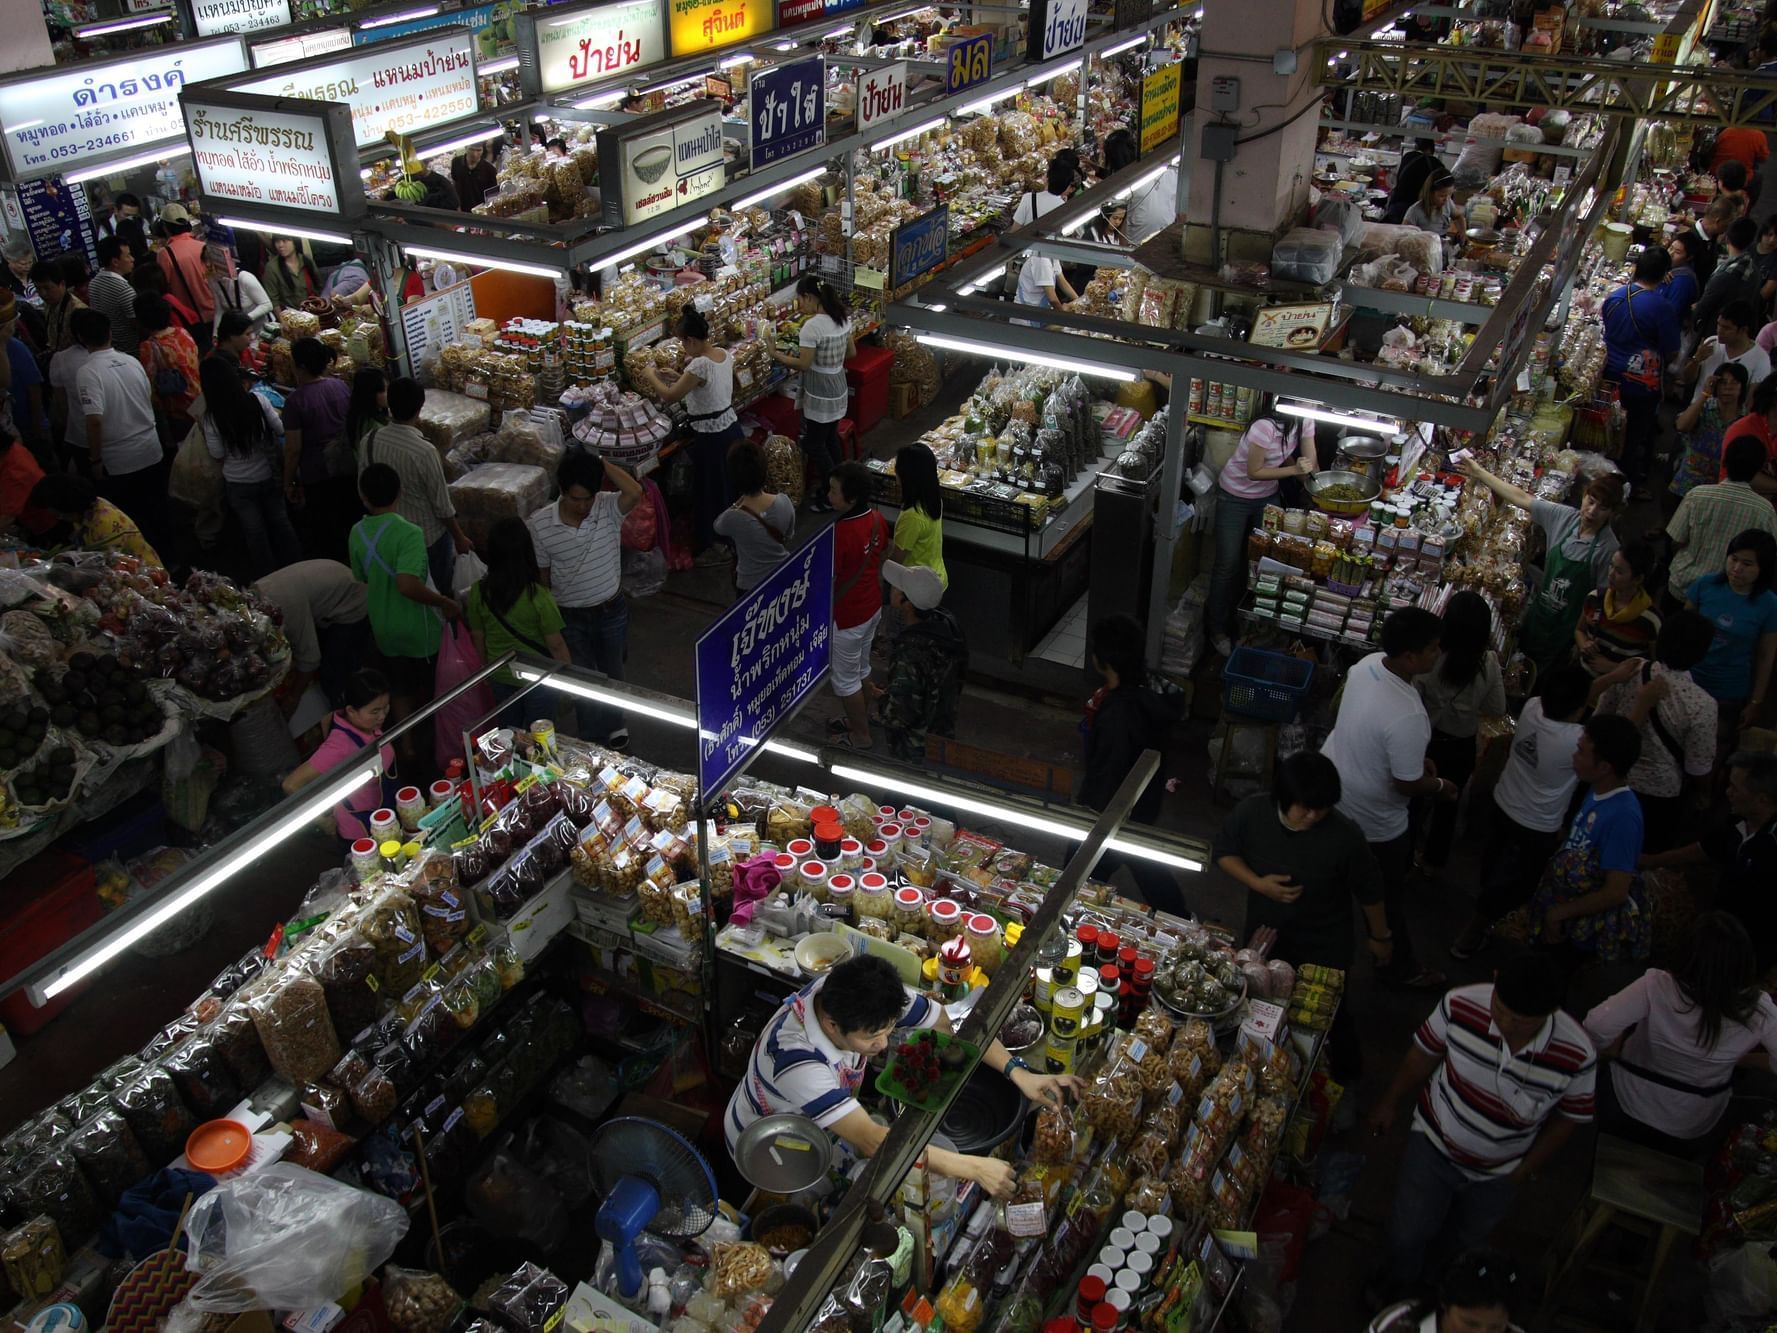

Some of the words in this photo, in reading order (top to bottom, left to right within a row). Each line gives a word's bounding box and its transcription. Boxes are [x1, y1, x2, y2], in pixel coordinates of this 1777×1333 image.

[373, 48, 469, 88] แหนมป้าย่น
[569, 30, 640, 79] ป้าย่น
[72, 60, 187, 107] ดำรงค์
[16, 122, 68, 146] หมูทอด
[75, 108, 111, 129] ไส้อั่ว
[50, 130, 135, 158] 053-234661
[192, 110, 314, 151] ร้านศรีพรรณ
[196, 150, 235, 170] หมูทอด
[233, 148, 265, 172] ไส้อั่ว
[268, 151, 331, 185] น้ำพริกหนุ่ม
[209, 180, 262, 199] แหนมหม้อ
[731, 613, 810, 700] น้ำพริกหนุ่ม
[752, 706, 776, 741] (053)
[780, 667, 813, 710] 251737
